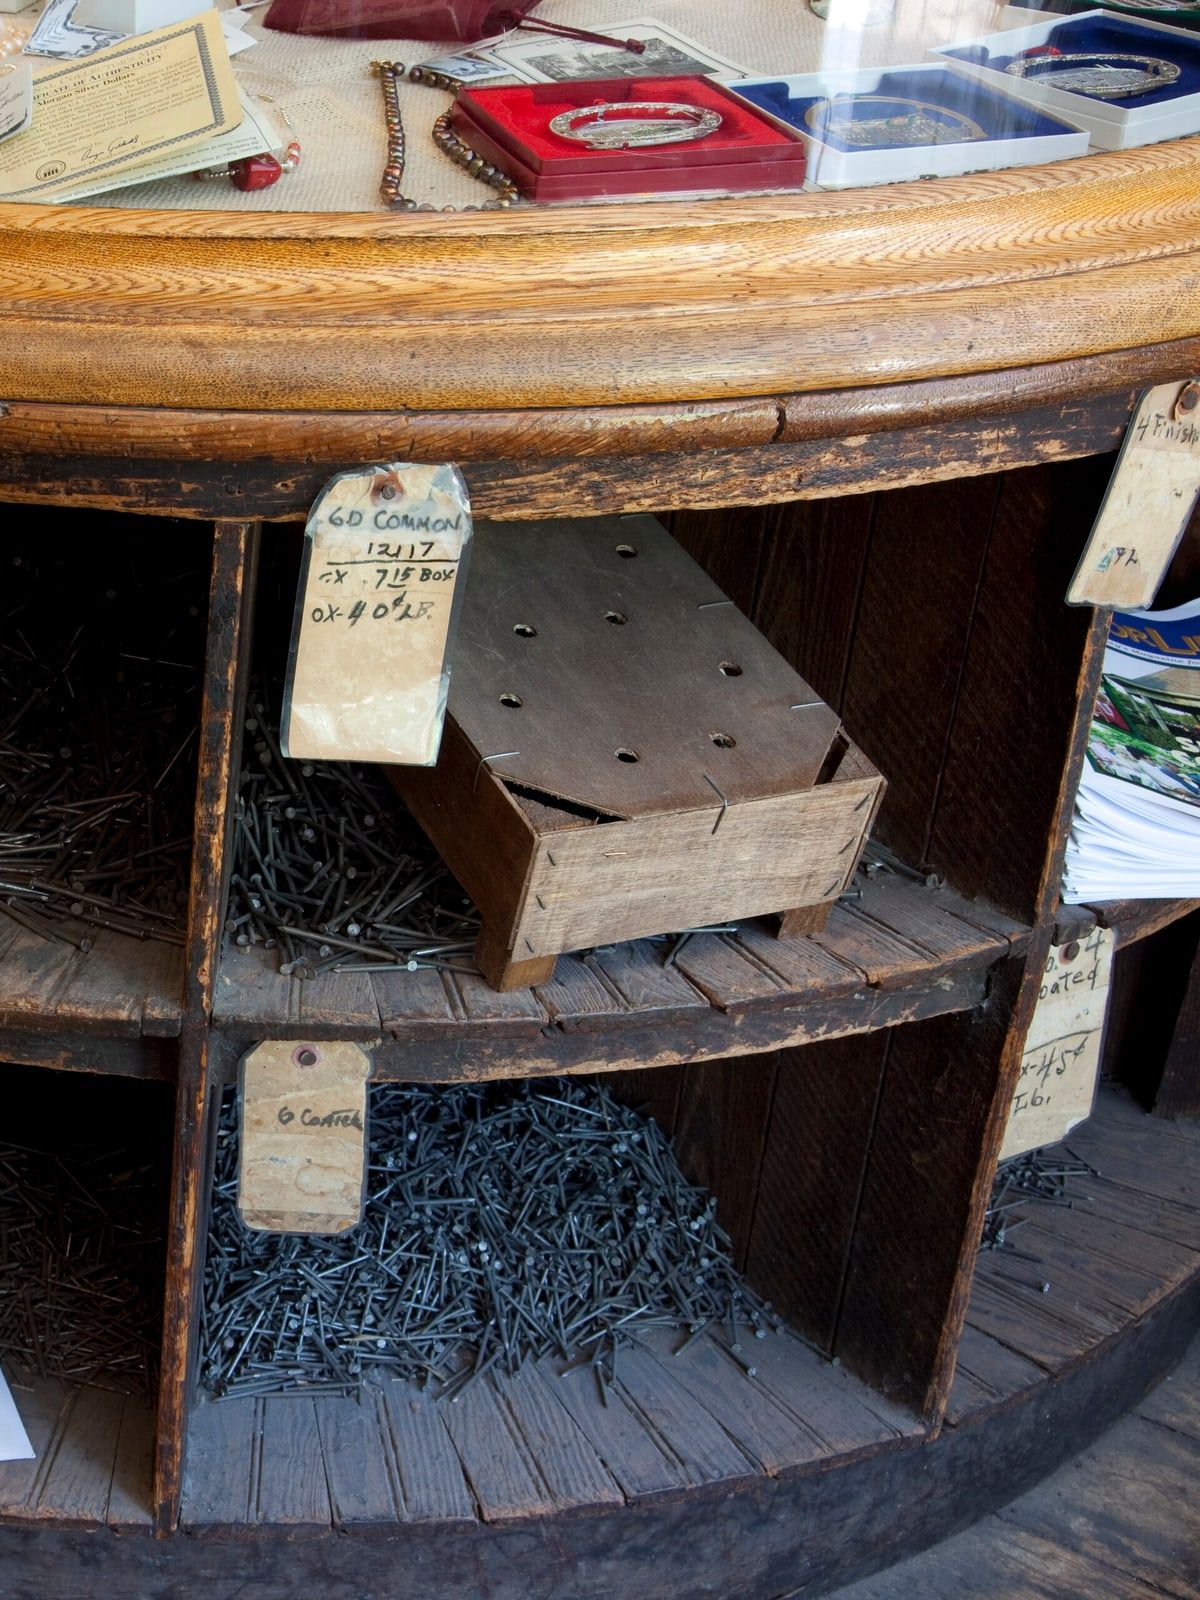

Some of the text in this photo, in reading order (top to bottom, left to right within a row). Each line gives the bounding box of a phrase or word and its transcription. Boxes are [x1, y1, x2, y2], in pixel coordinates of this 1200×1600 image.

[37, 73, 136, 106] Morgan Silver Dollars
[1136, 414, 1153, 442] 4
[373, 509, 462, 532] COMMON
[419, 567, 456, 582] BOX
